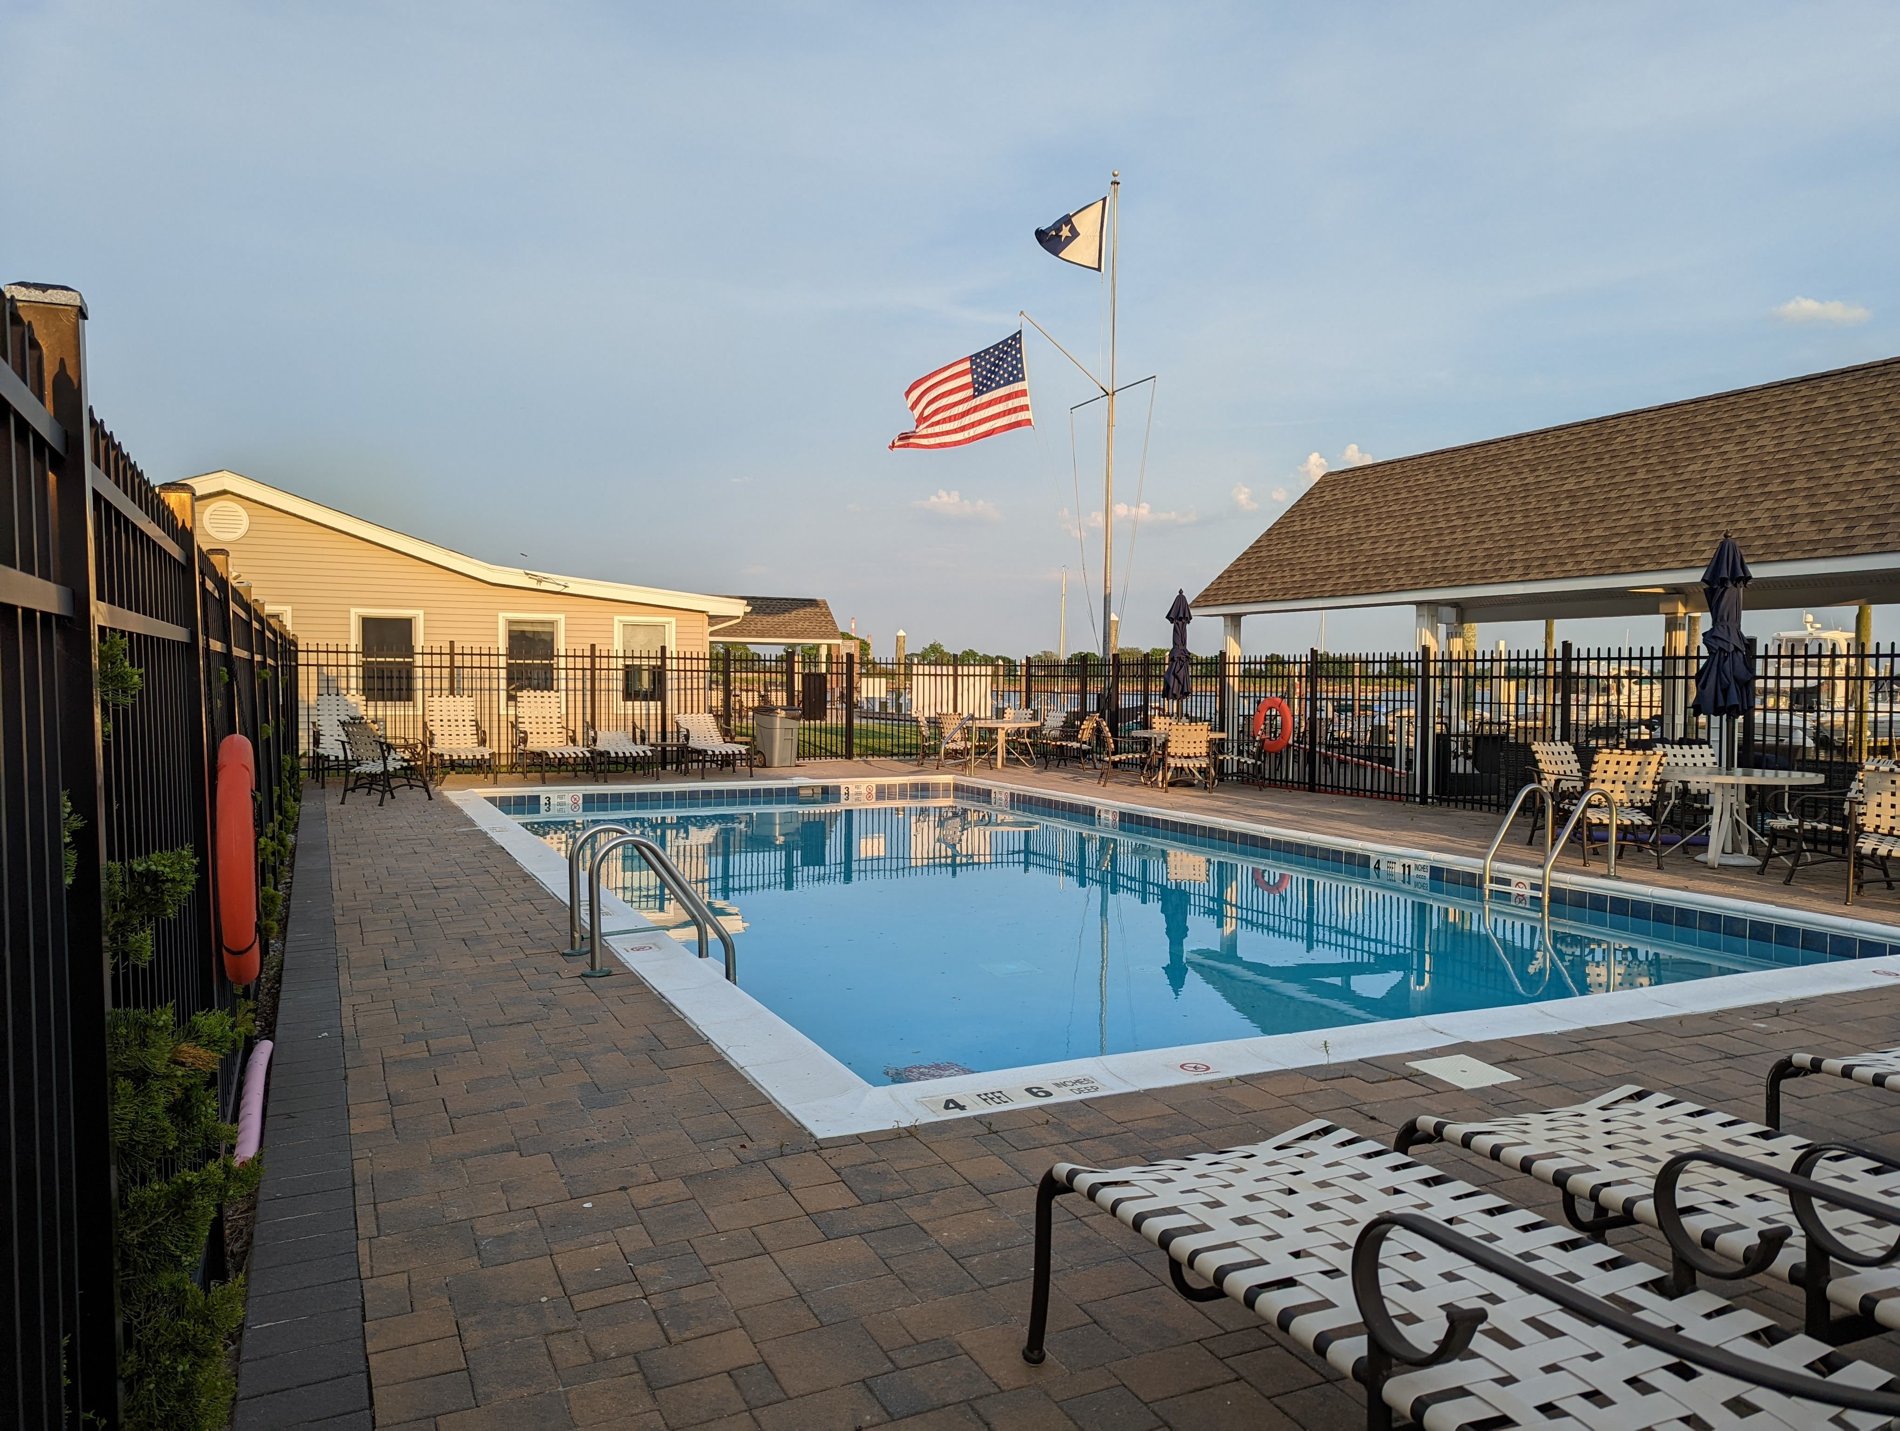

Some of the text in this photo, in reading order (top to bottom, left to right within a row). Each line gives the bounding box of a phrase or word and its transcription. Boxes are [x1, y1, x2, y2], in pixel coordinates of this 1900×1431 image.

[1373, 859, 1381, 870] 4
[1401, 863, 1411, 875] 11
[1414, 863, 1429, 873] INCHES
[943, 1078, 1095, 1111] 4 FEET 6 INCHES
[1069, 1085, 1100, 1095] DEEP
